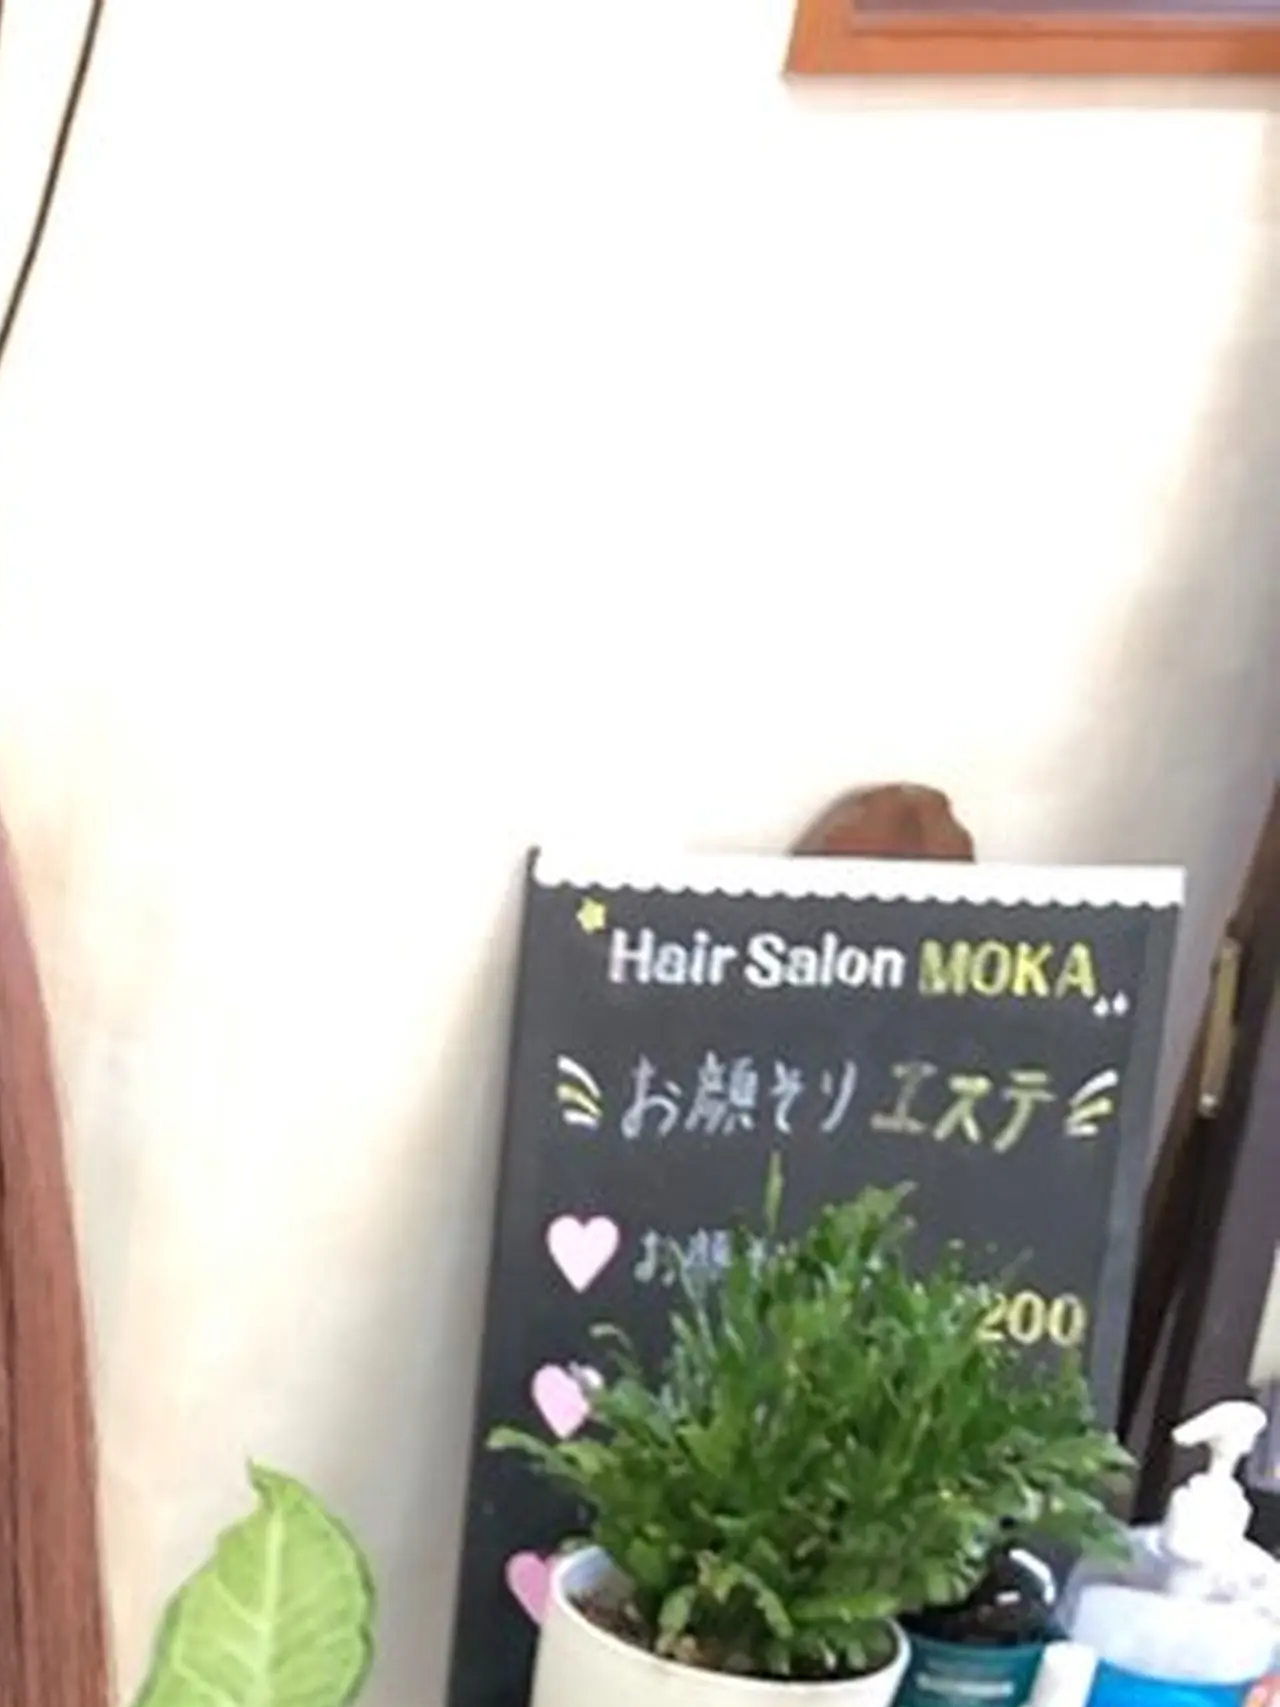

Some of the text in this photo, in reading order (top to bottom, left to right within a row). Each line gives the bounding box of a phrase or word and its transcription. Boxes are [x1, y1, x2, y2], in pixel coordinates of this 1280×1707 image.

[608, 927, 1098, 1000] Hair Salon MOKA
[620, 1051, 1056, 1154] お顔そり エステ
